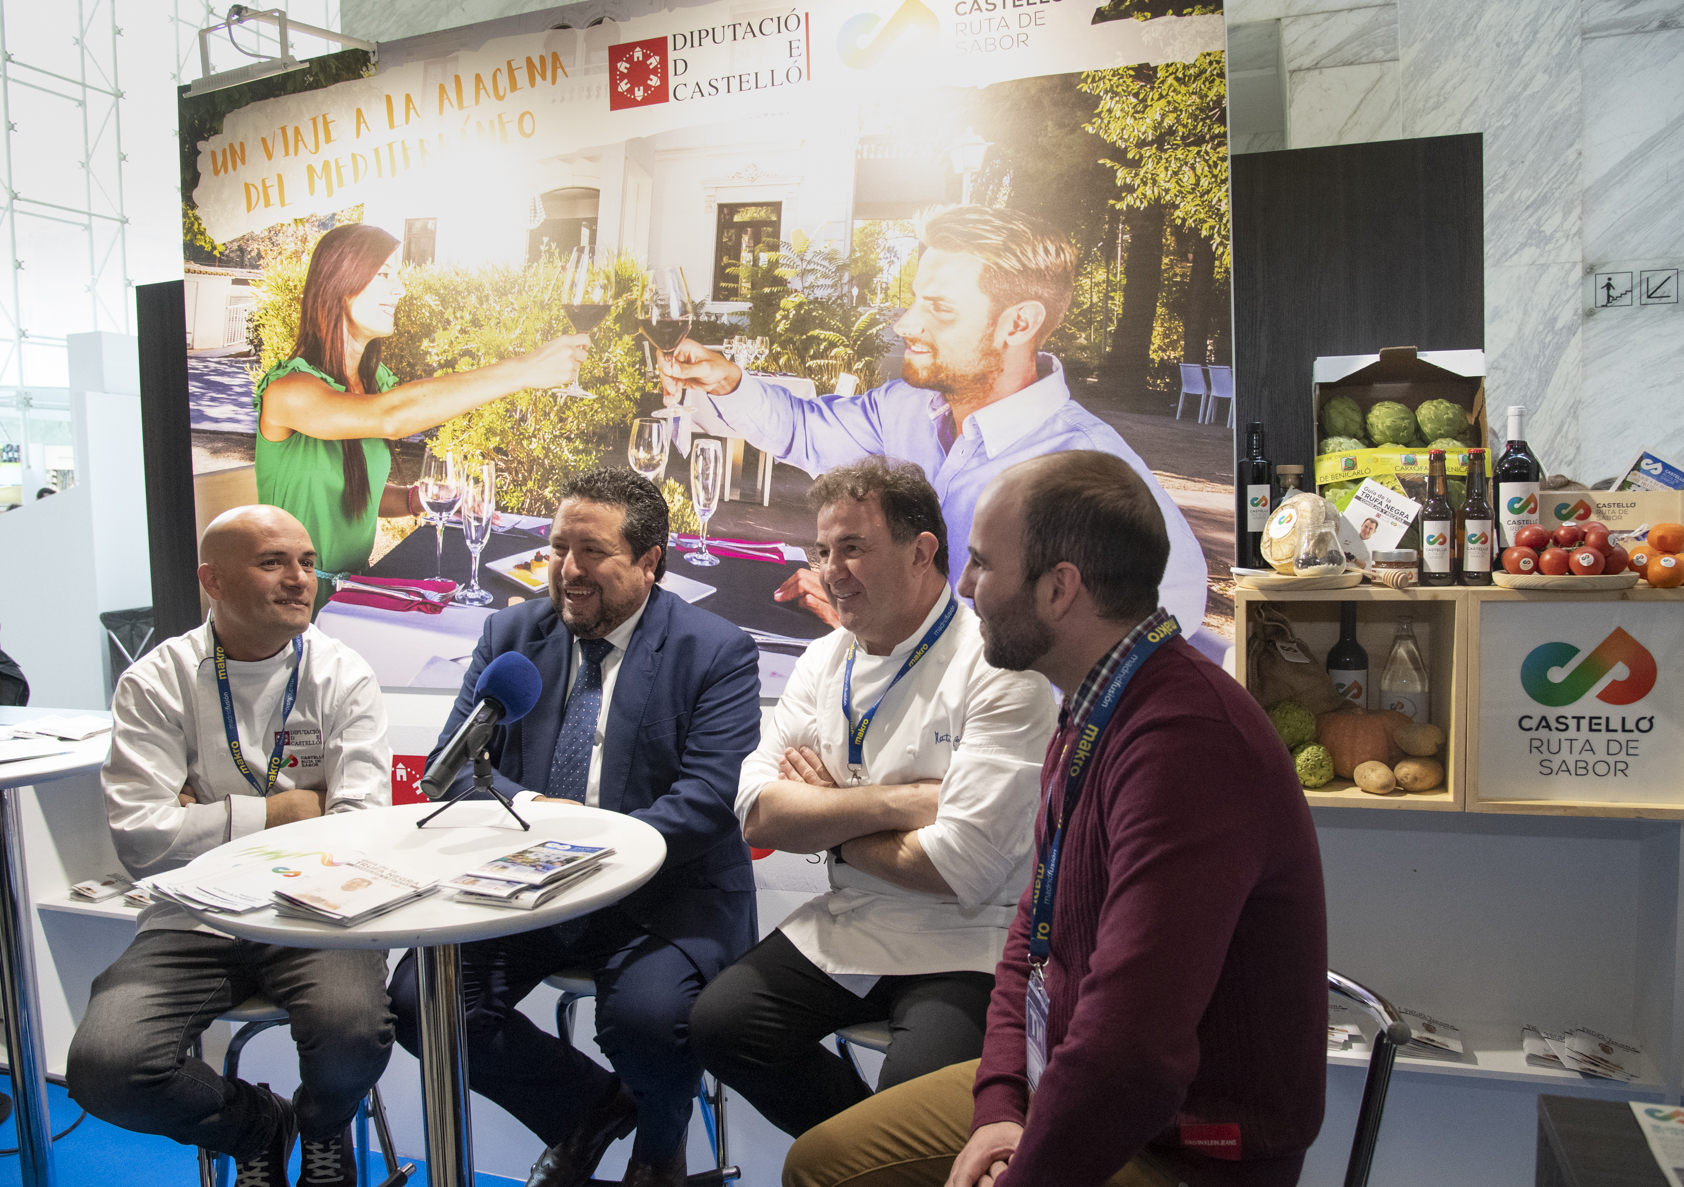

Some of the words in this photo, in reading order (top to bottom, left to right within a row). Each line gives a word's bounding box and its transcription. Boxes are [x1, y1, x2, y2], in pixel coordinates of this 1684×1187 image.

[672, 7, 801, 52] DIPUTACIÓ
[955, 16, 1010, 37] RUTA
[1018, 10, 1046, 29] DE
[673, 58, 688, 77] D
[788, 39, 802, 58] E
[955, 32, 1029, 57] SABOR
[672, 60, 802, 102] CASTELLÓ
[210, 141, 246, 177] UN
[260, 112, 337, 161] VIAJE
[355, 107, 371, 140] A
[385, 93, 420, 131] LA
[438, 51, 569, 116] ALACENA
[244, 172, 293, 214] DEL
[1331, 467, 1372, 480] BENICARLÓ
[1361, 490, 1383, 506] TRUFA
[1384, 504, 1410, 520] NEGRA
[1364, 486, 1376, 496] Guía
[1147, 618, 1178, 643] makro
[216, 646, 228, 680] makro
[908, 643, 928, 668] makro
[1101, 654, 1138, 708] madridfusión
[854, 718, 869, 746] makro
[1518, 715, 1655, 734] CASTELLÓ
[231, 741, 250, 774] makro
[1070, 724, 1099, 778] makro
[1529, 738, 1596, 756] RUTA
[1606, 739, 1640, 756] DE
[1539, 759, 1629, 778] SABOR
